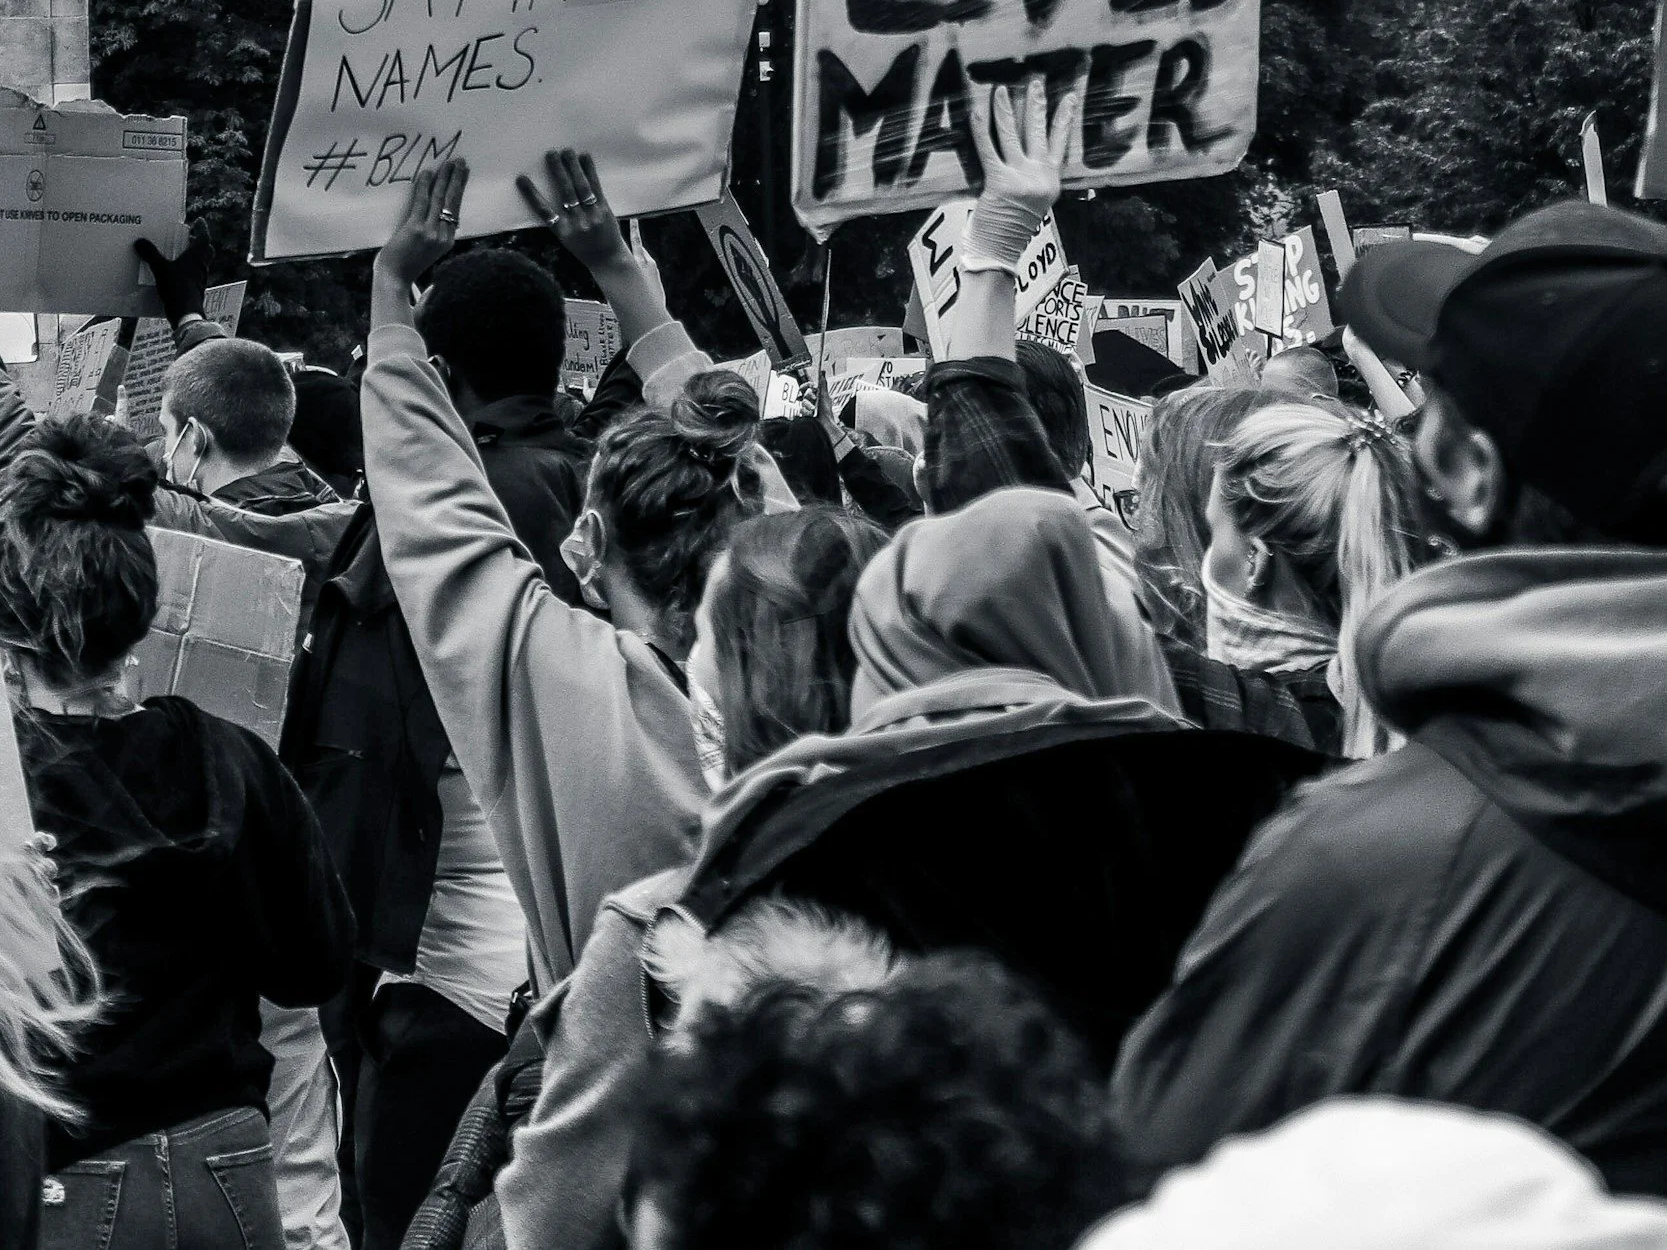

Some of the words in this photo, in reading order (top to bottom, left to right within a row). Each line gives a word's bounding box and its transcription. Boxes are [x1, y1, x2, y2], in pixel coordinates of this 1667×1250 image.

[331, 27, 544, 113] NAMES.
[47, 211, 60, 222] TO
[62, 212, 88, 224] OPEN
[89, 214, 143, 226] PACKAGING
